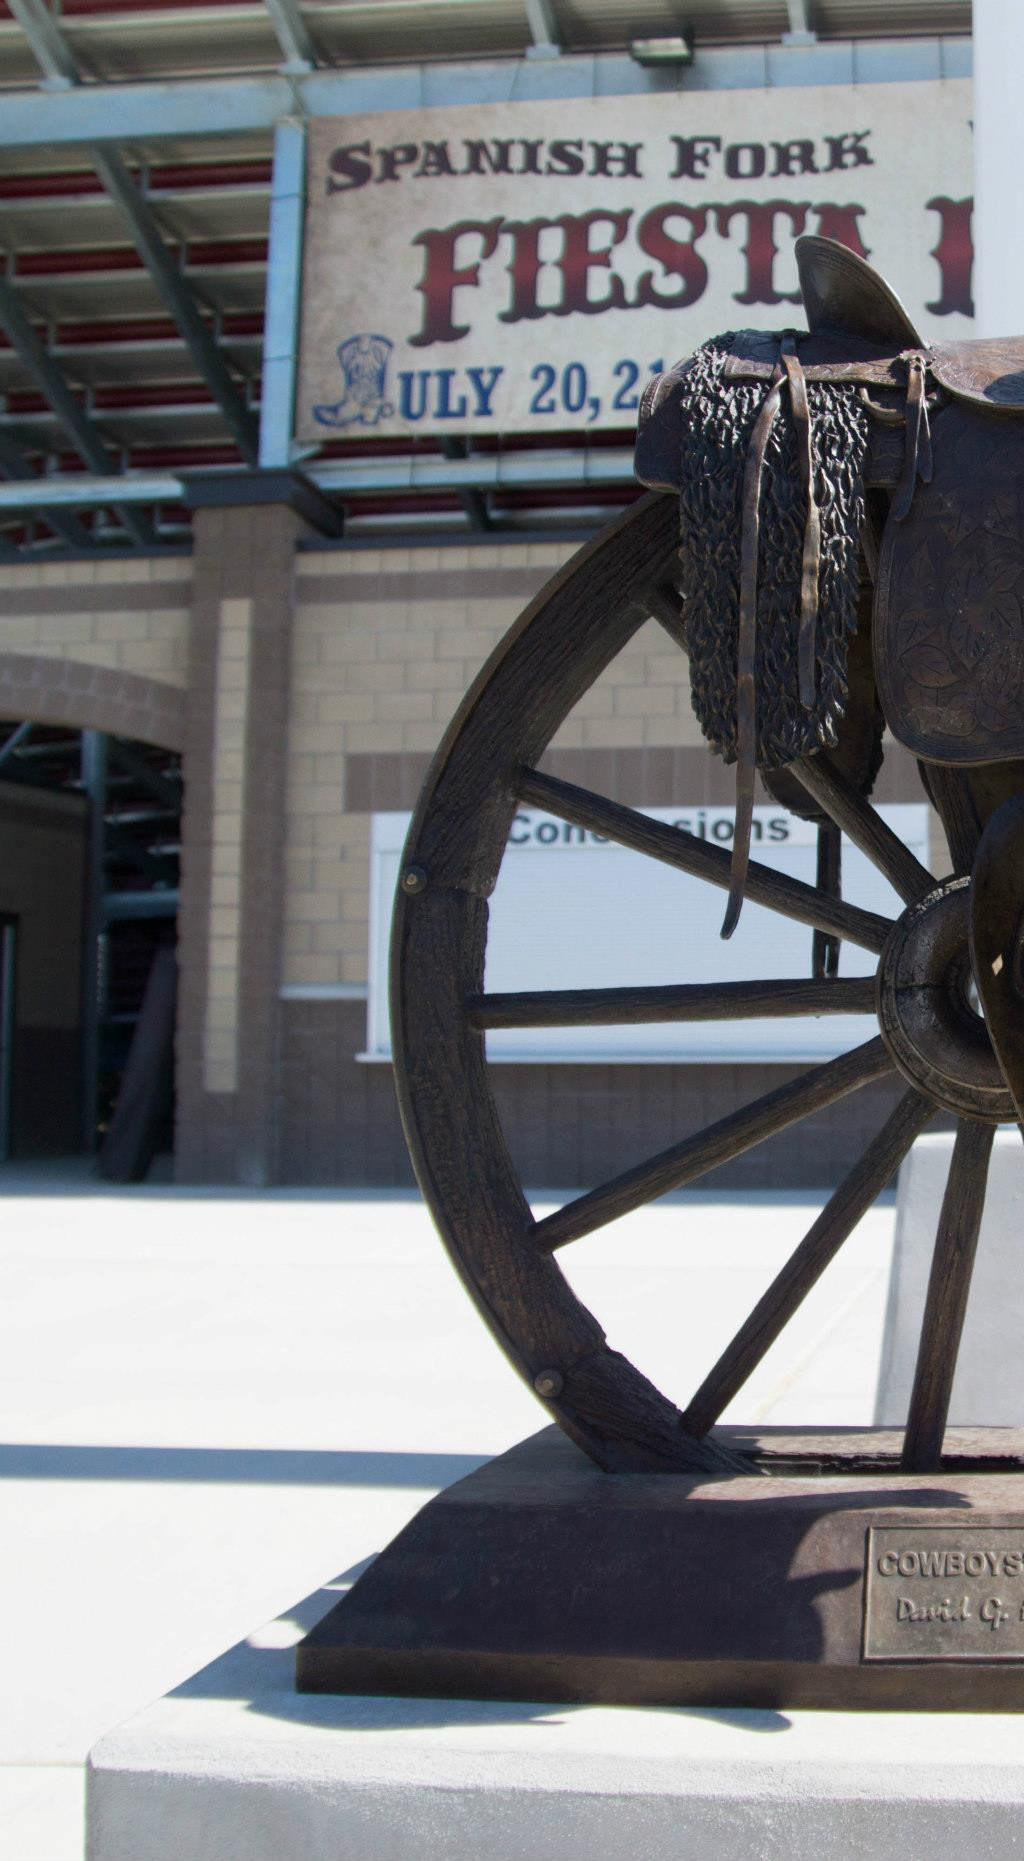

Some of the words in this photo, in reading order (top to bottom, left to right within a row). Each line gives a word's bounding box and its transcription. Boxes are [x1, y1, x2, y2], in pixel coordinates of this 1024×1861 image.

[529, 358, 664, 424] 20,2
[509, 811, 790, 844] Consions
[896, 1596, 972, 1623] David
